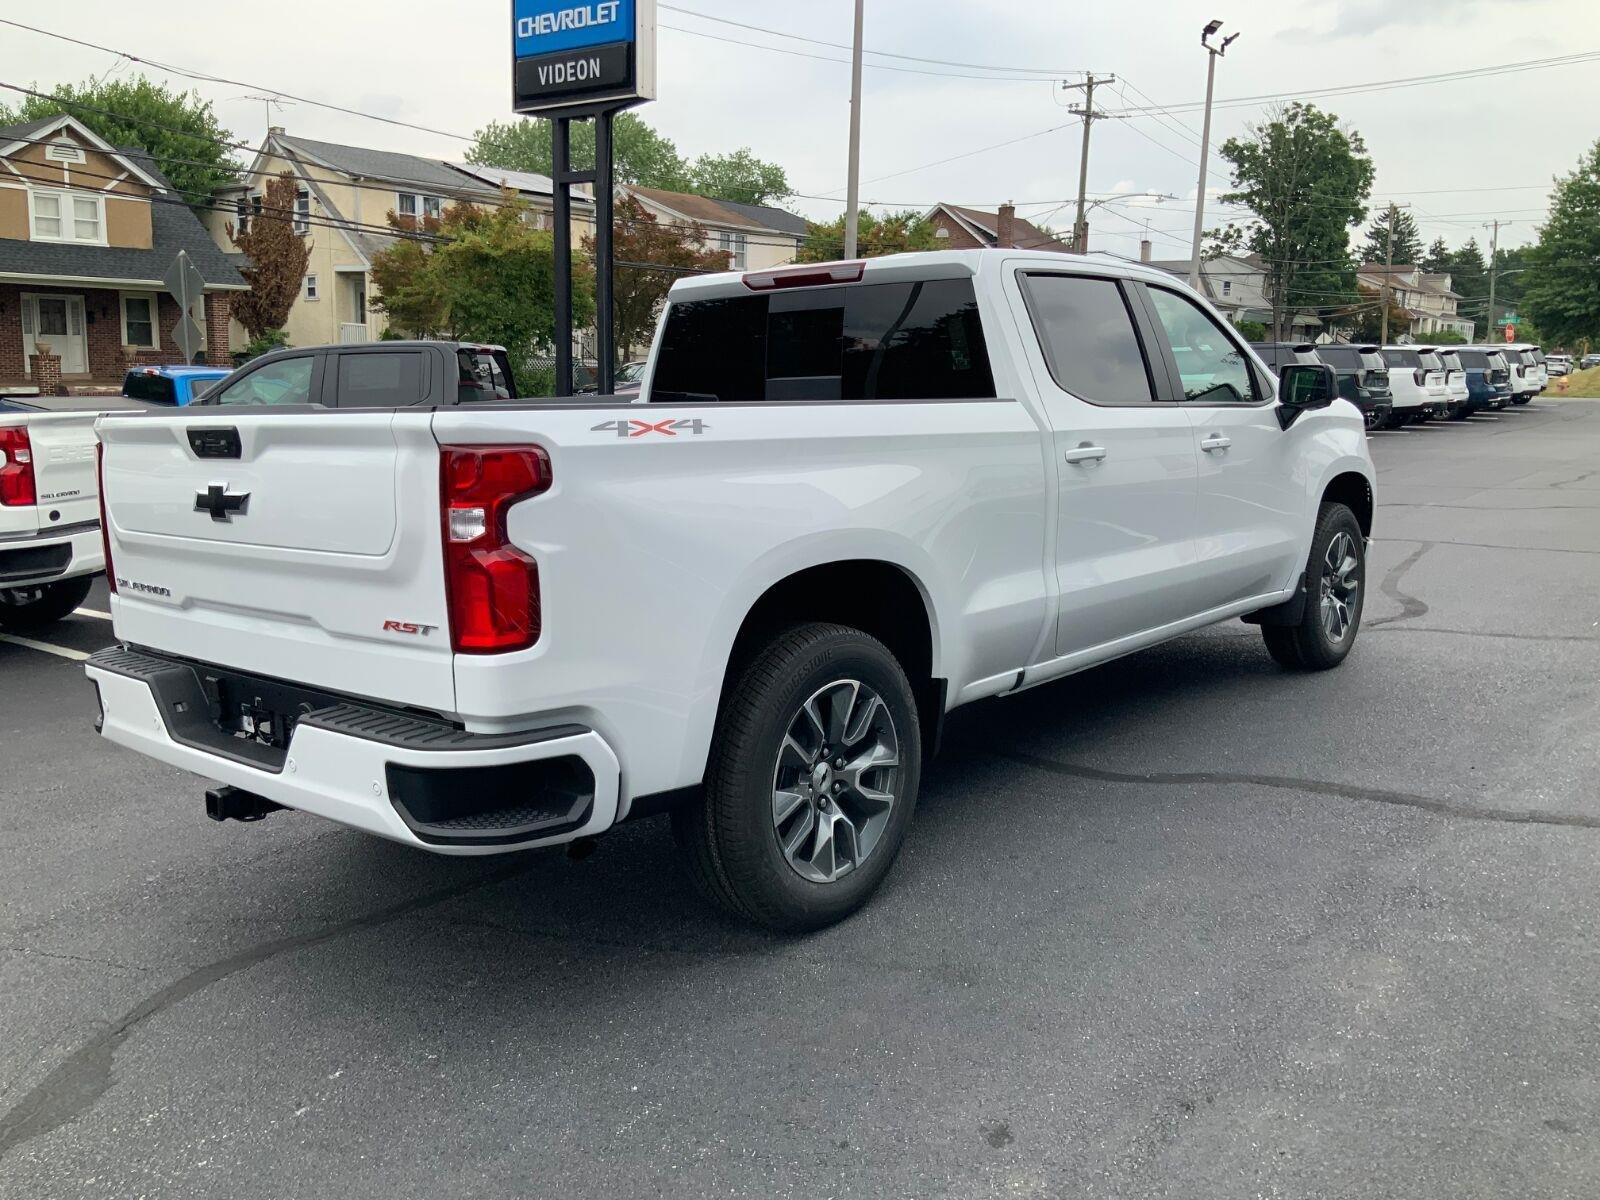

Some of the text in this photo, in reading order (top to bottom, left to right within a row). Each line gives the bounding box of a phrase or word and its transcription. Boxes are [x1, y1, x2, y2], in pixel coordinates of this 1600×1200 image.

[518, 1, 620, 38] CHEVROLET
[538, 57, 600, 86] VIDEON
[383, 620, 439, 636] RST
